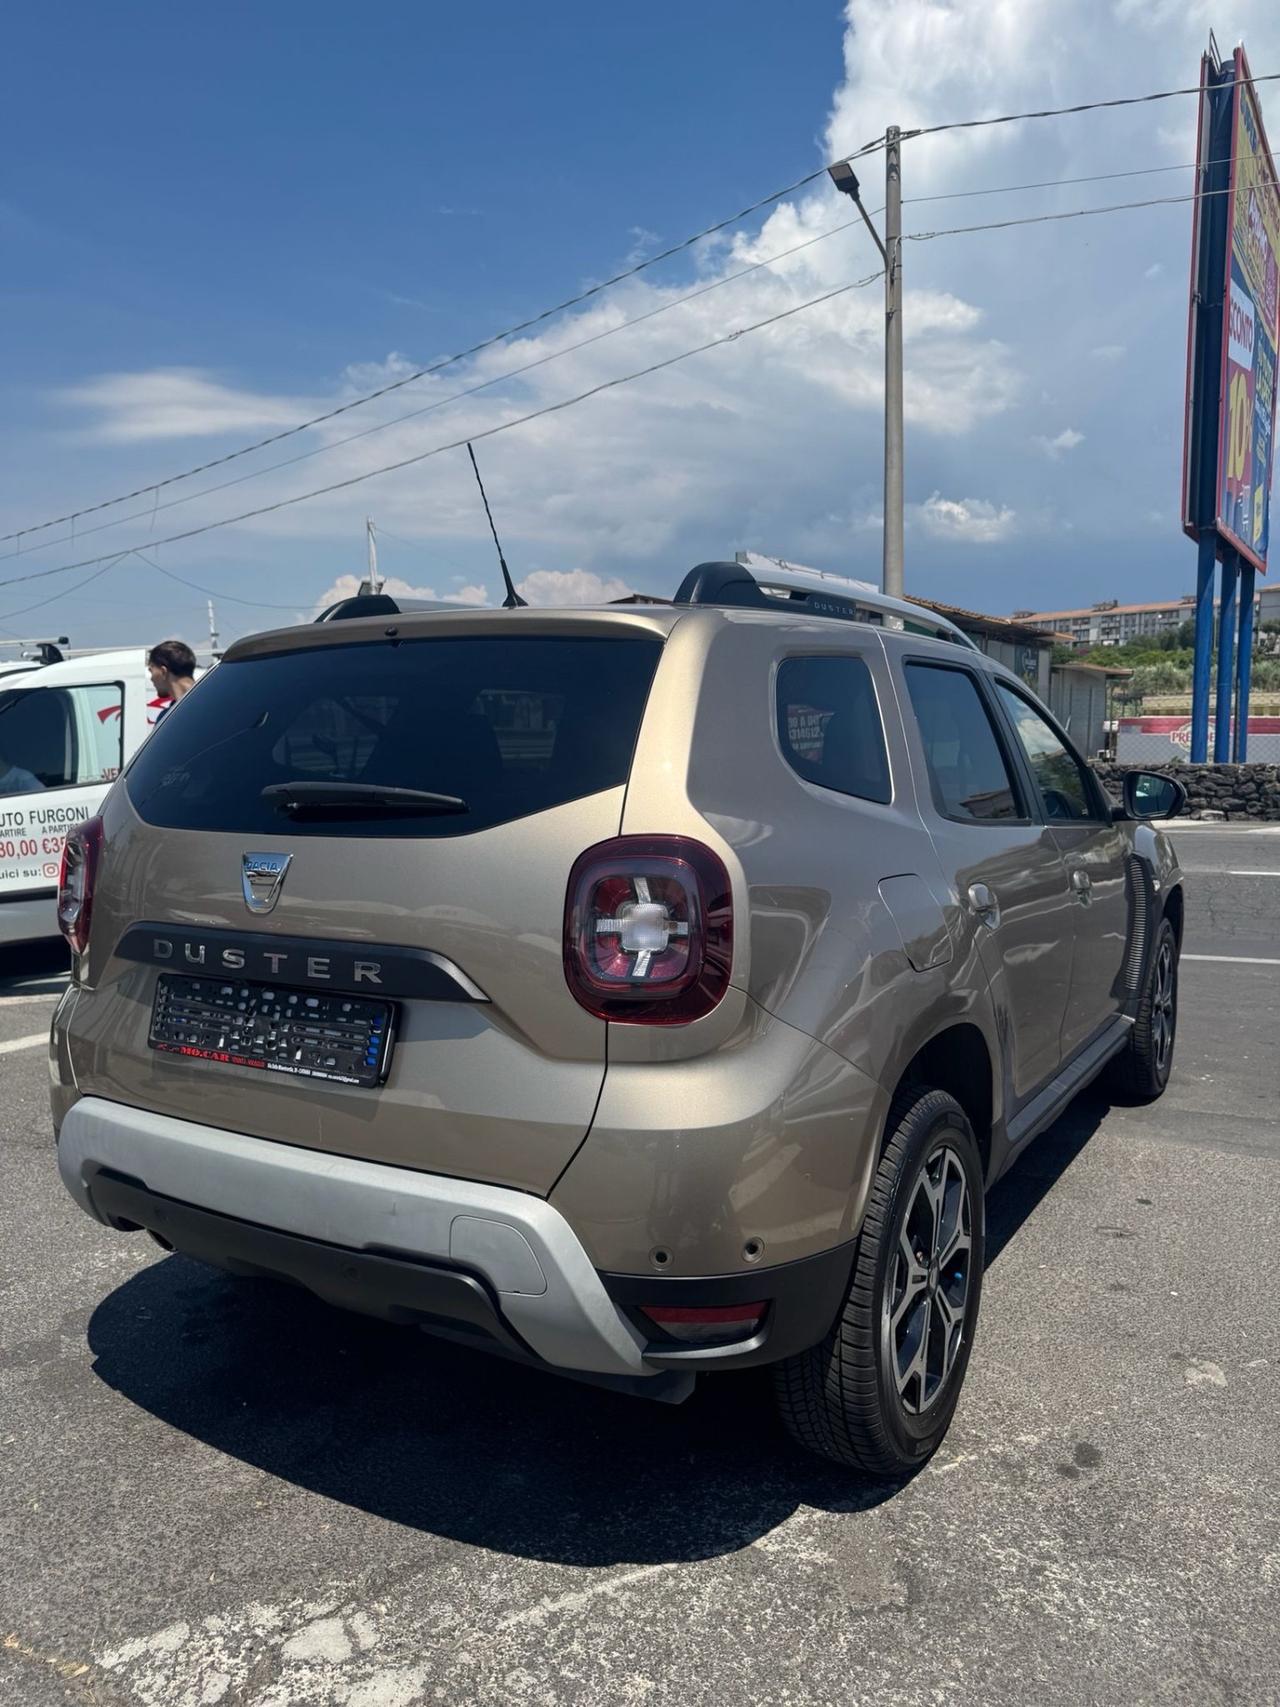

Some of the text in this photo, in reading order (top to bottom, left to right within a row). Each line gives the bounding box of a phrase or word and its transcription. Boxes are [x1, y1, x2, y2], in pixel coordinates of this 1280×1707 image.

[814, 601, 856, 615] DUSTER
[29, 806, 89, 825] FURGONI
[42, 826, 48, 834] A
[246, 861, 279, 872] DACIA
[23, 869, 42, 878] su:
[153, 938, 382, 984] DUSTER
